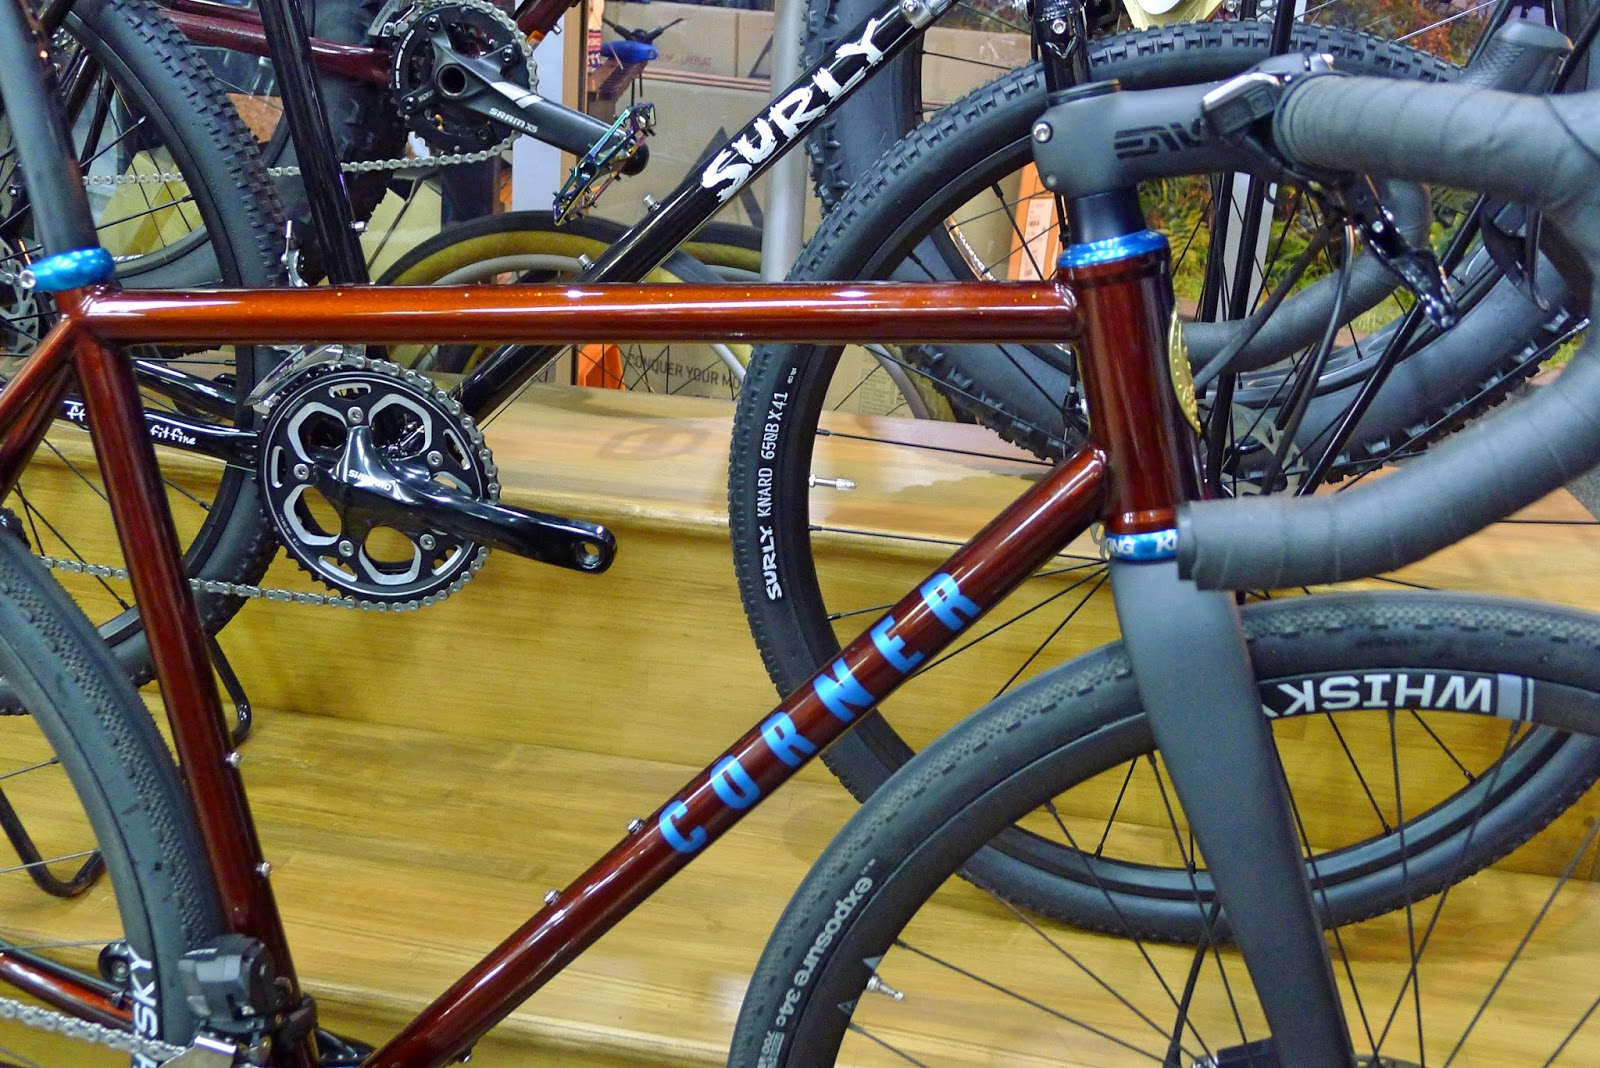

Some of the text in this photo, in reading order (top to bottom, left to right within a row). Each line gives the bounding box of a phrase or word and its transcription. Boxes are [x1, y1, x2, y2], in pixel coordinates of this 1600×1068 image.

[489, 107, 526, 128] SRAM
[702, 18, 883, 202] SURLY
[1113, 119, 1203, 160] ENV
[628, 353, 743, 389] CONQUER YOUR MO
[757, 467, 773, 517] KNARD
[759, 525, 783, 600] SURLY
[1156, 529, 1177, 553] KI
[658, 572, 982, 854] CORNER
[1262, 673, 1492, 718] WHISK
[776, 876, 873, 1027] exposure 34c
